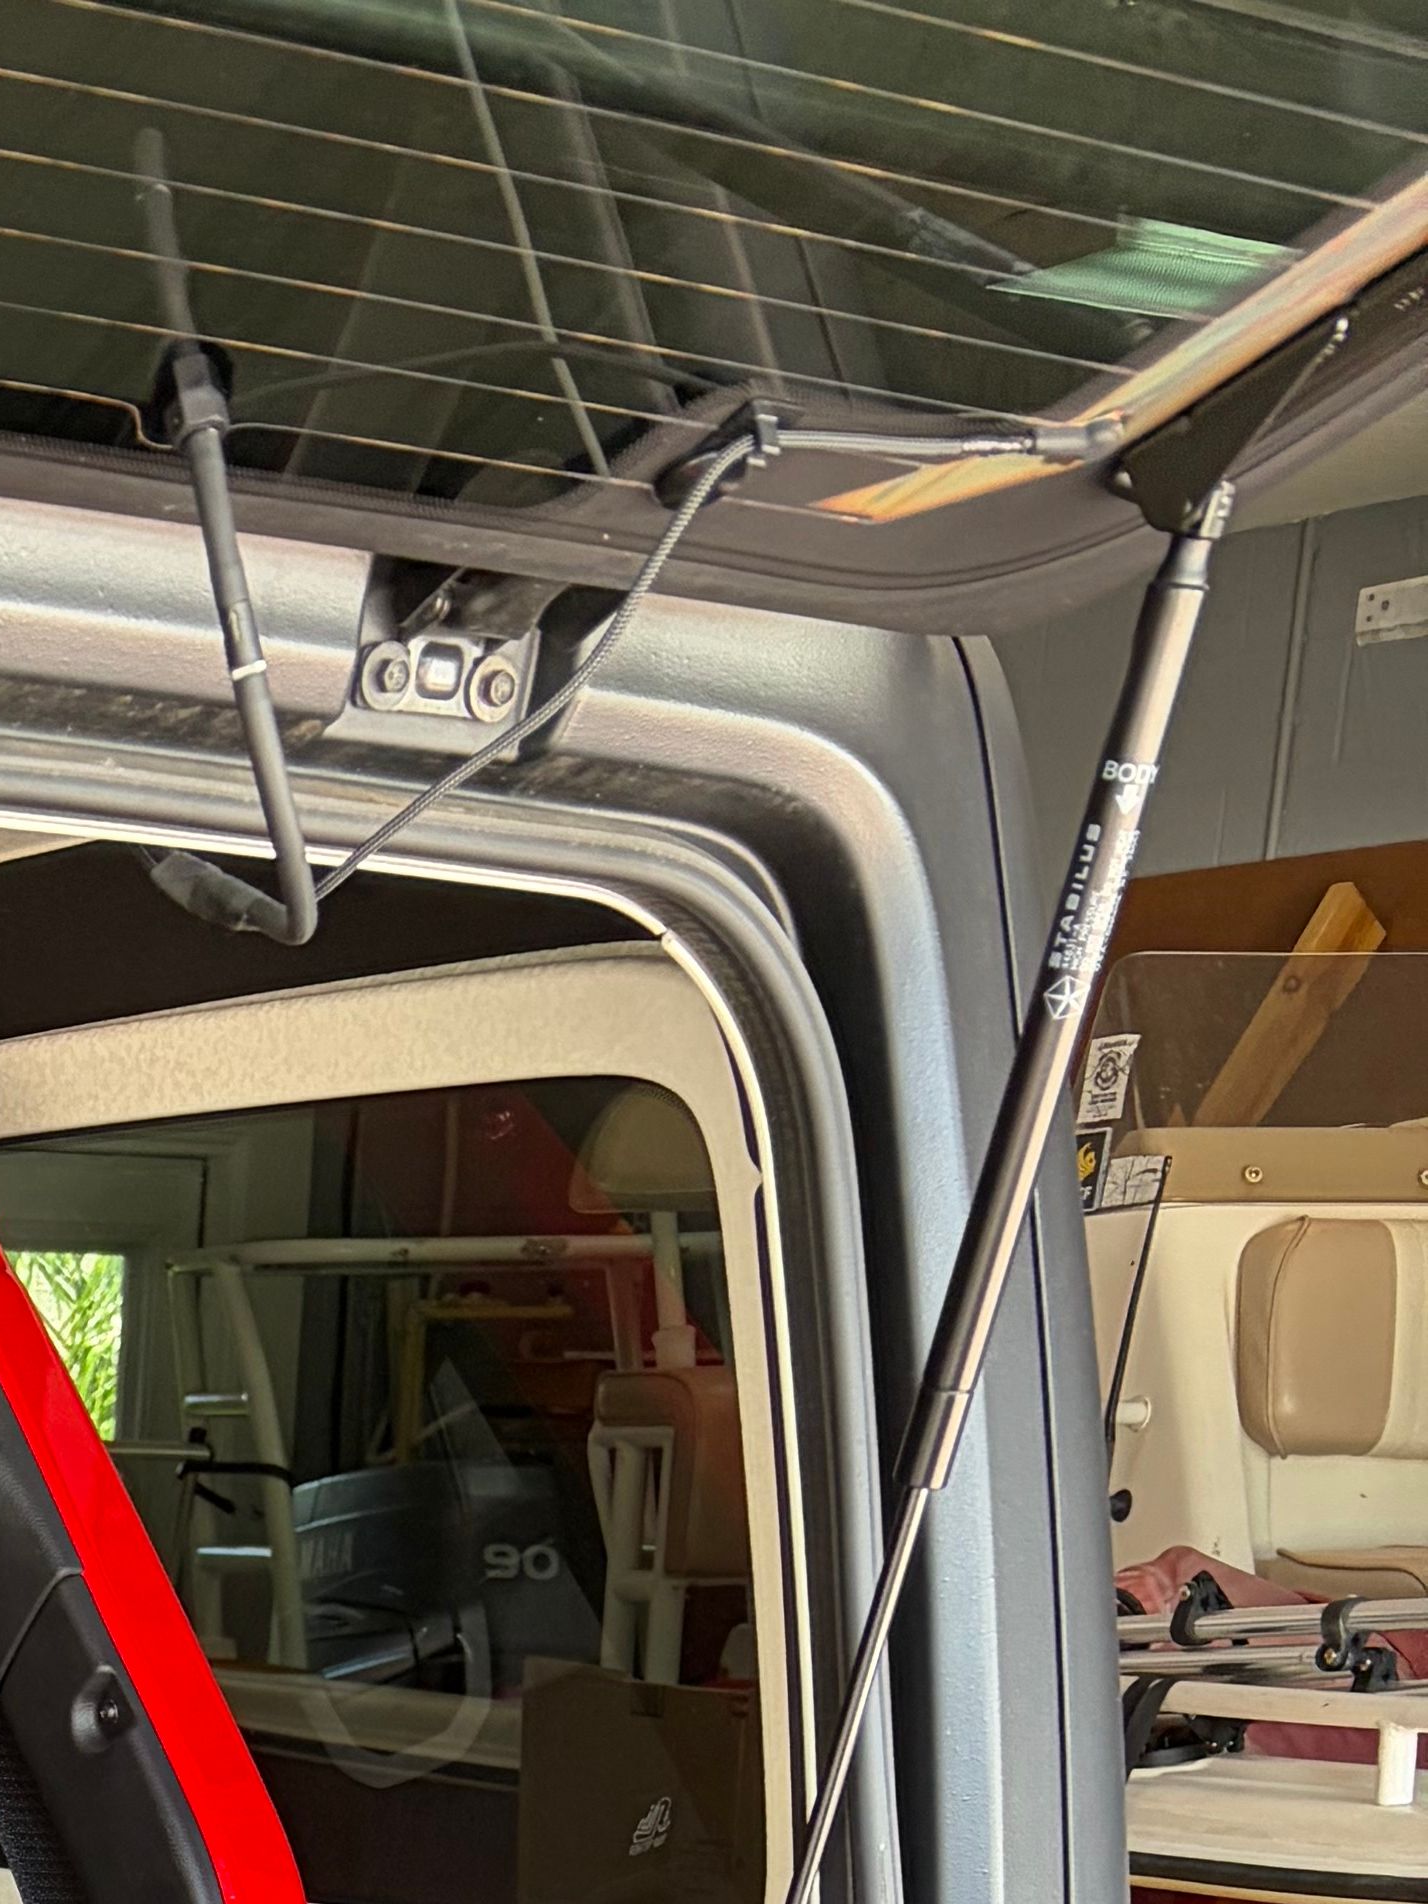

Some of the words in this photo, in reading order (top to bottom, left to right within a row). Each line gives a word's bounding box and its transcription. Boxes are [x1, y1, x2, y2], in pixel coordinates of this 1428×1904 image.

[1101, 759, 1160, 785] BODY
[1047, 823, 1101, 970] STABILUS
[481, 1542, 561, 1581] 90
